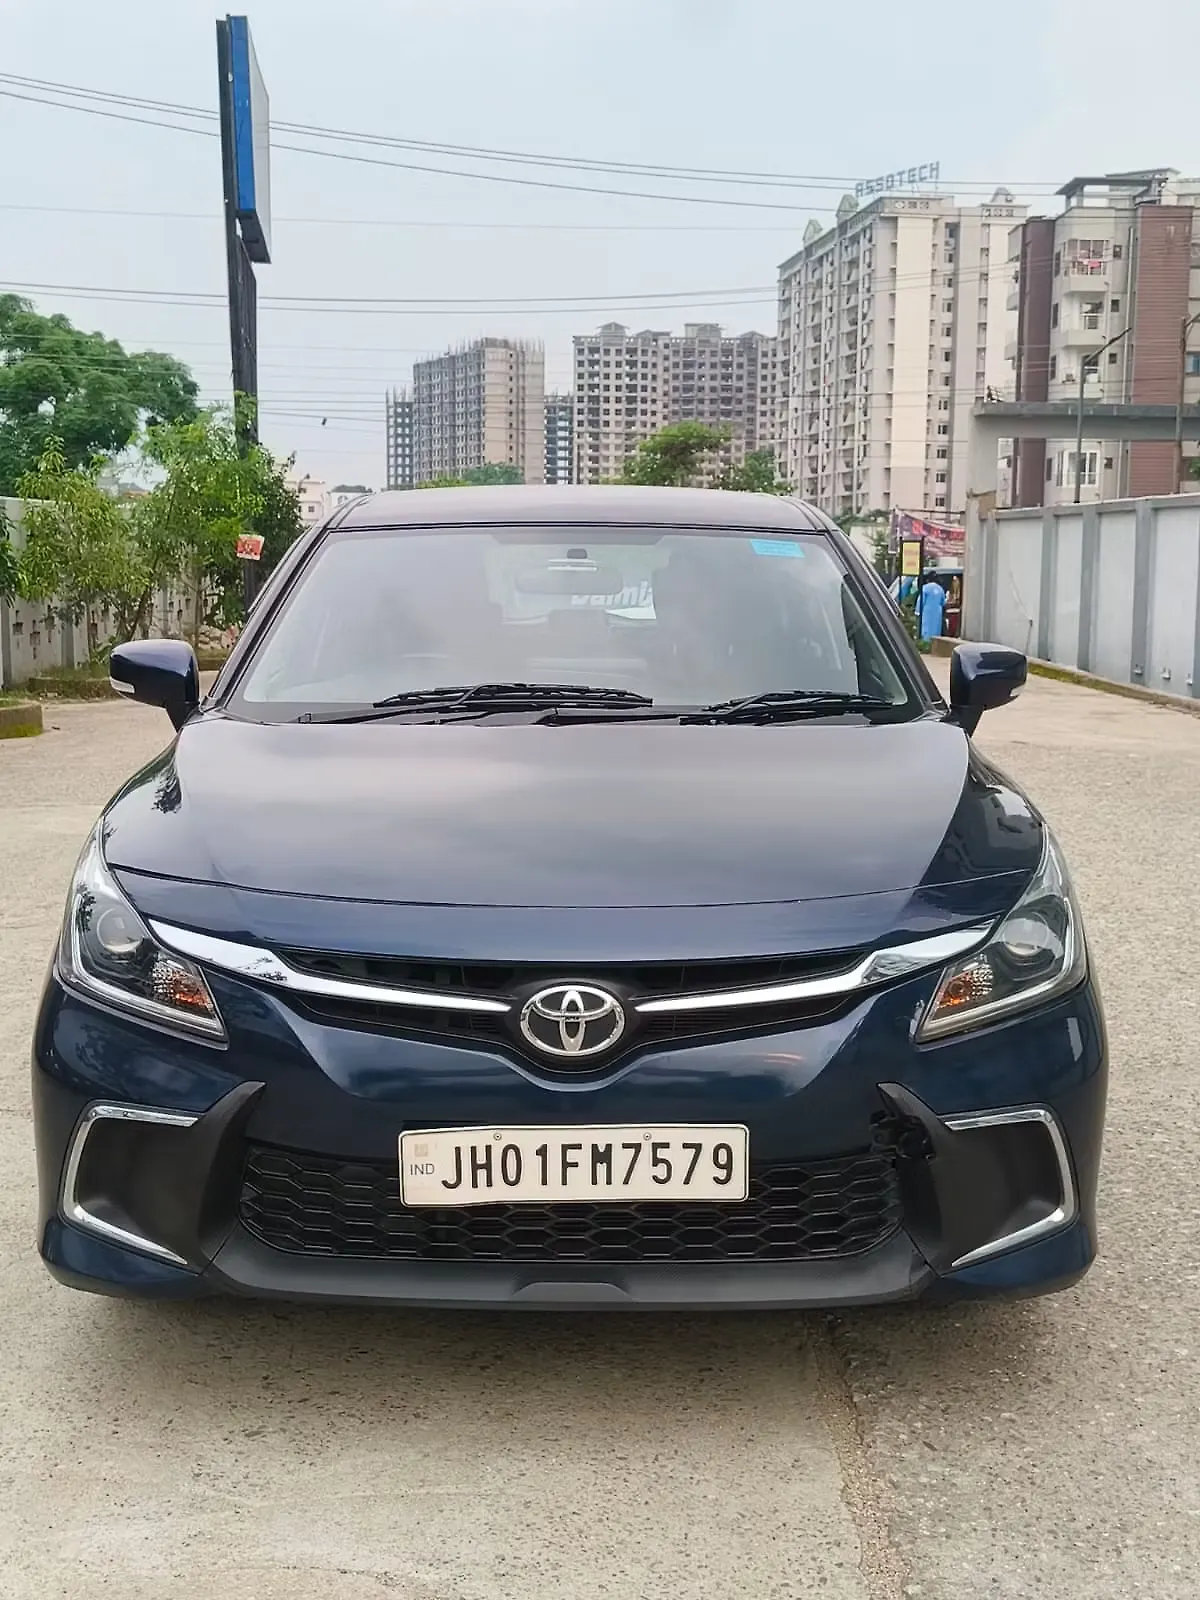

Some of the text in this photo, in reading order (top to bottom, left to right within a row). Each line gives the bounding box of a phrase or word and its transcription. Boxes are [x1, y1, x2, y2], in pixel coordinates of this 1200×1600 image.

[855, 160, 940, 198] ASSOTECH
[409, 1163, 435, 1176] IND
[441, 1142, 734, 1189] JH01FM7579
